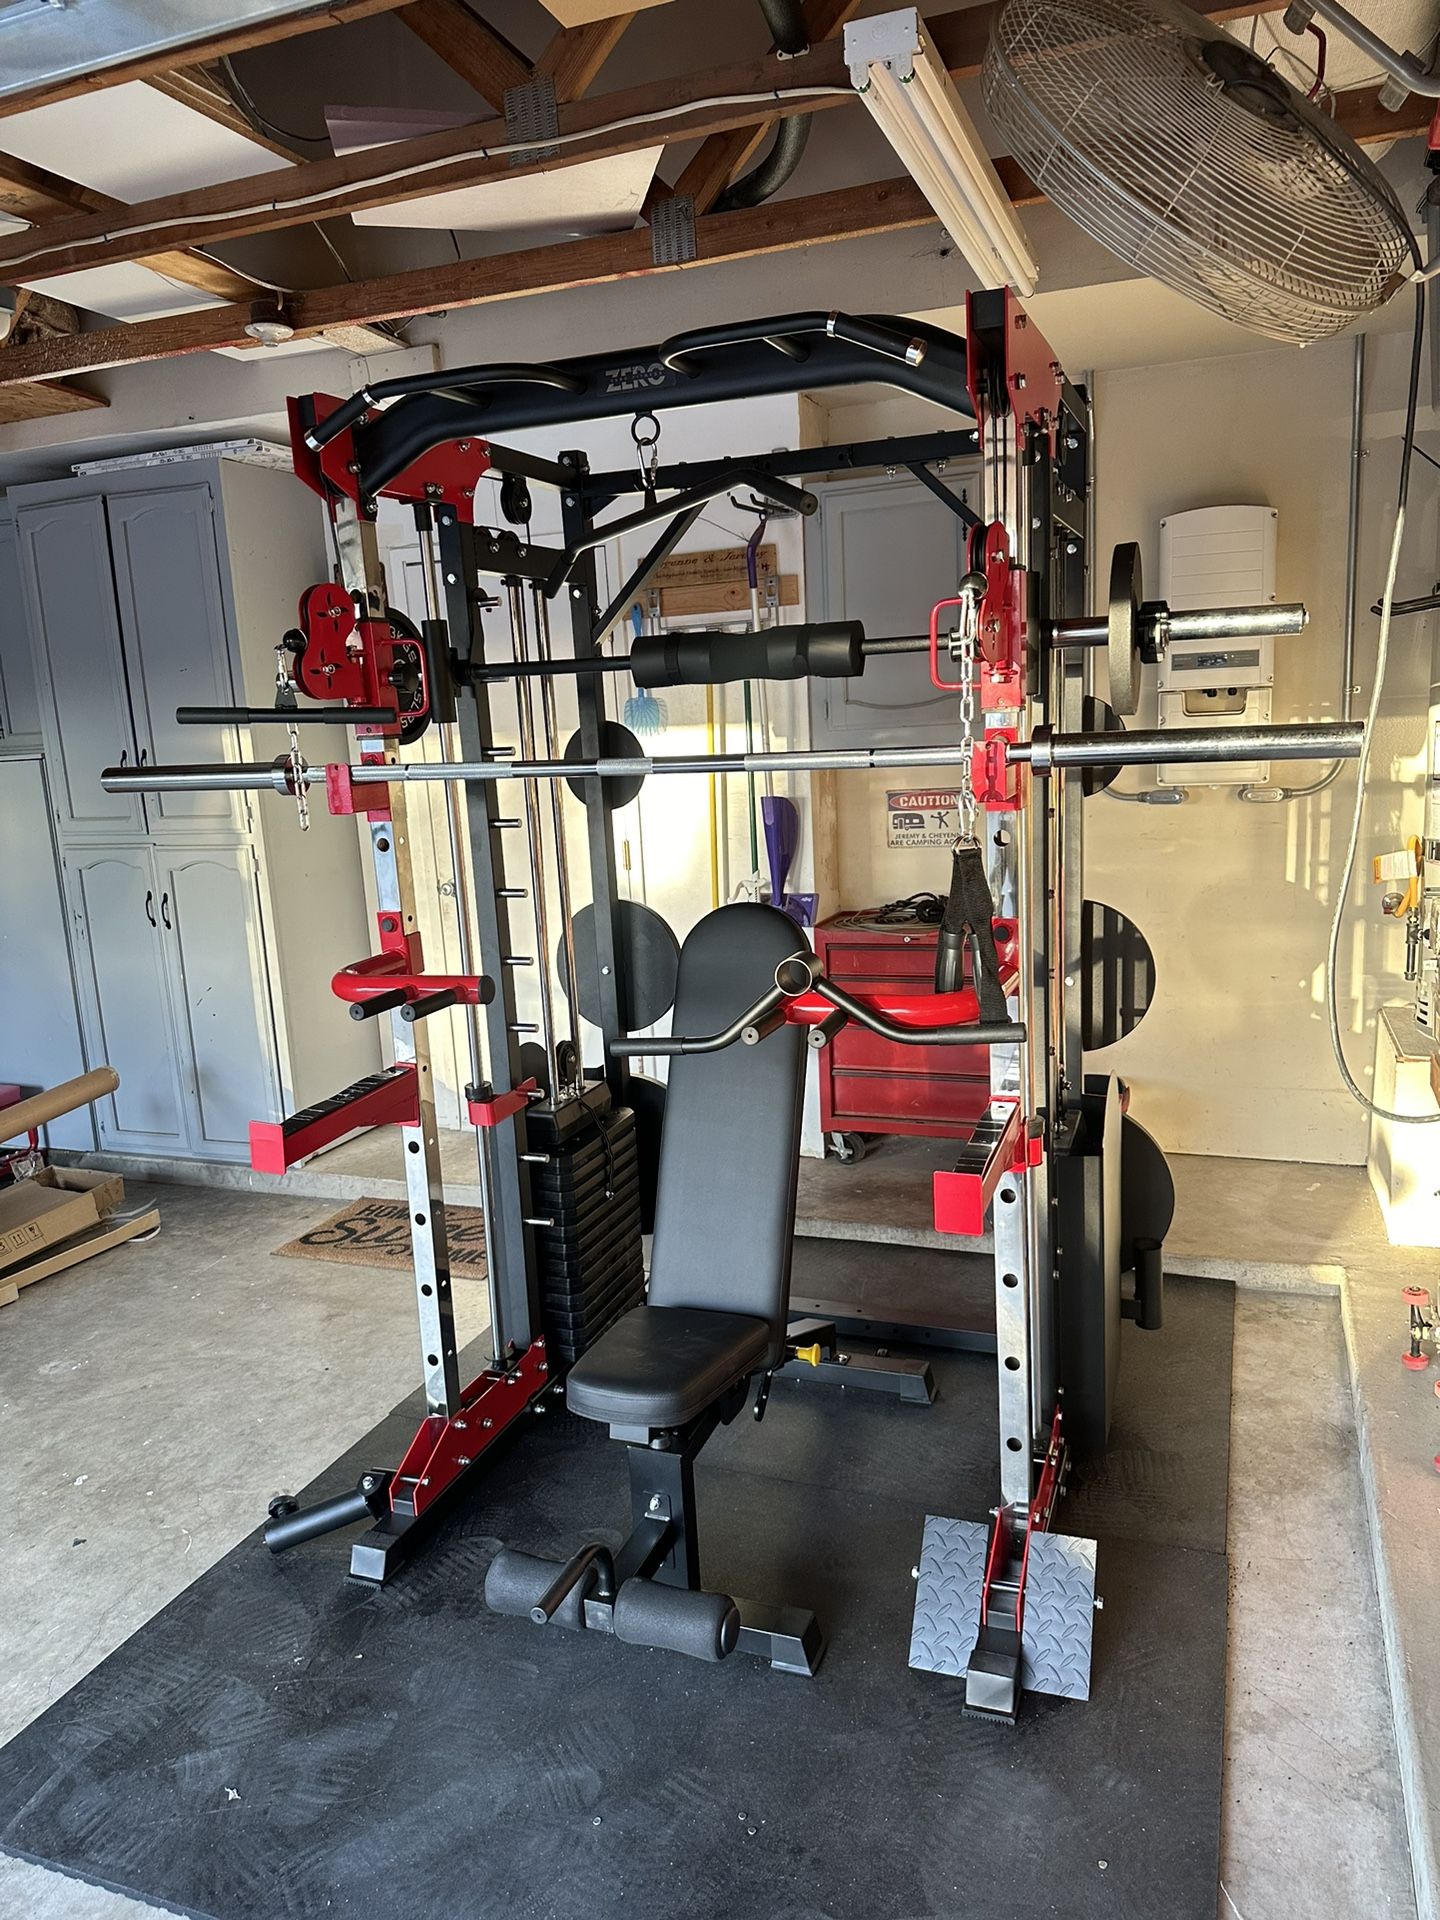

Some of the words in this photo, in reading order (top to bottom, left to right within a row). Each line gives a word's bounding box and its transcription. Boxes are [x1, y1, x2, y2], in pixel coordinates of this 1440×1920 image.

[605, 362, 666, 393] ZERO
[899, 794, 960, 808] CAUTION
[890, 839, 904, 847] ARE
[905, 838, 942, 846] CAMPING
[895, 832, 920, 840] JEREMY
[921, 832, 928, 840] &
[928, 831, 962, 840] CHEYENN
[356, 1203, 411, 1221] HOM
